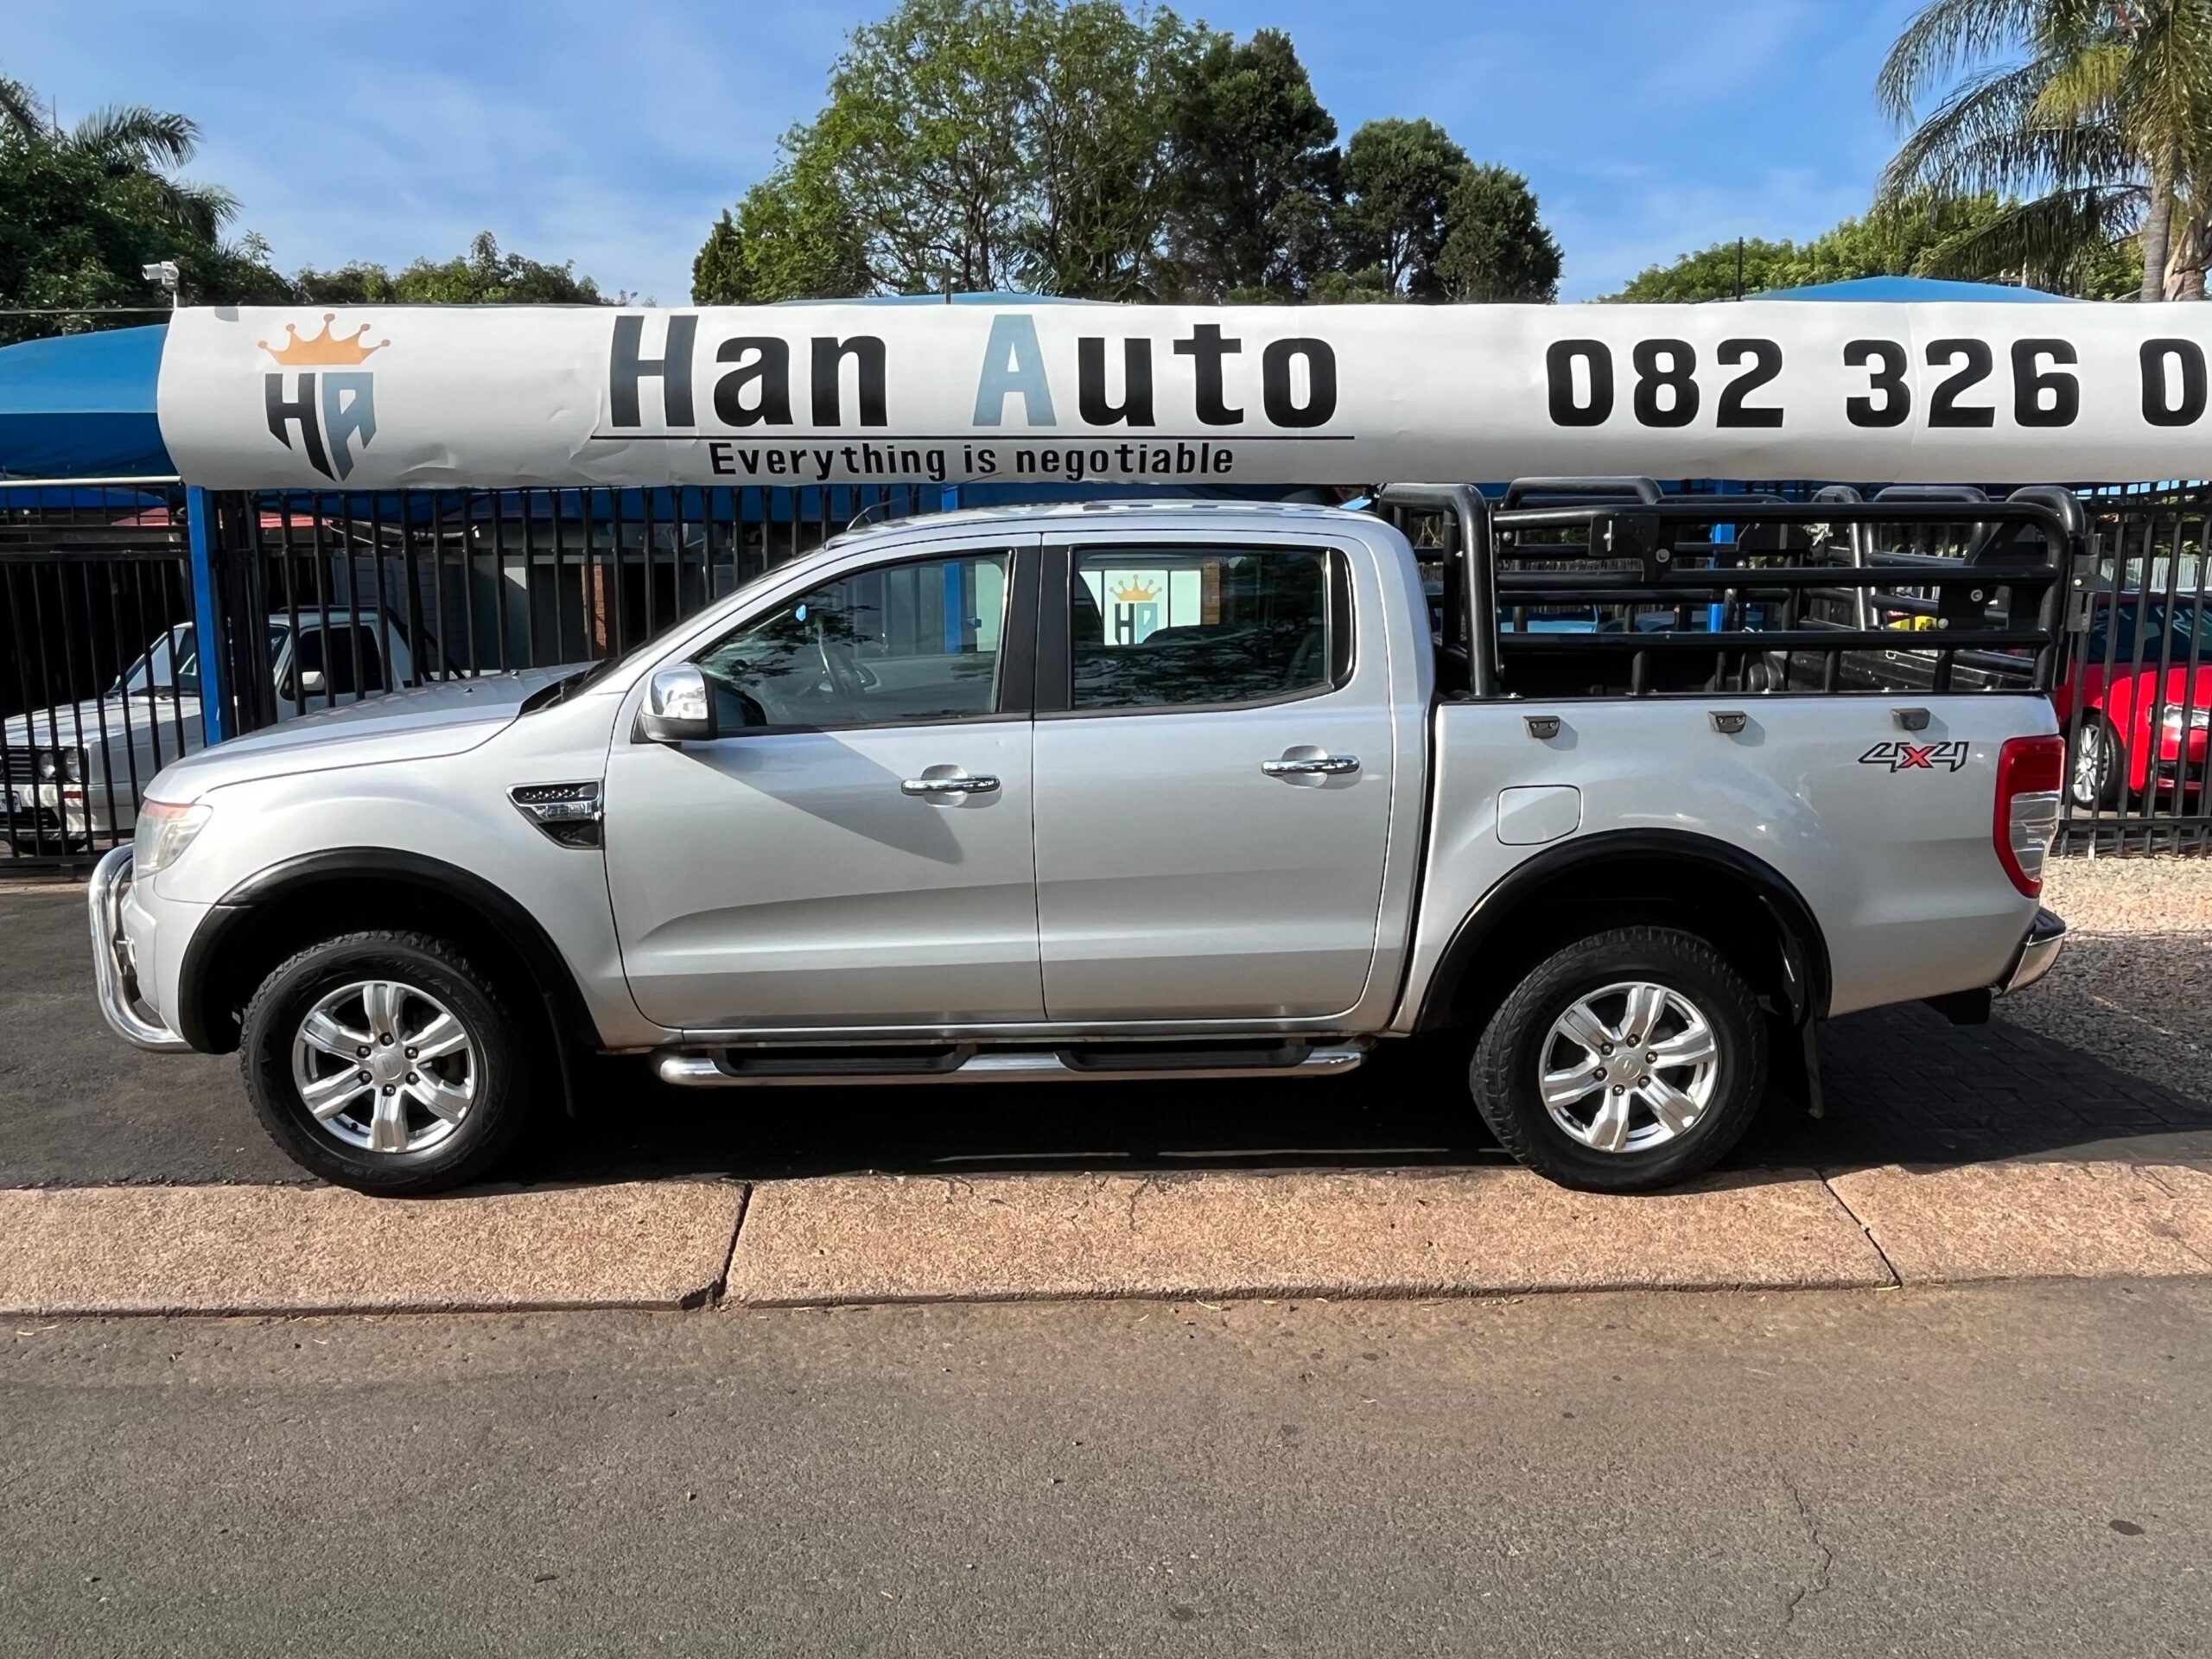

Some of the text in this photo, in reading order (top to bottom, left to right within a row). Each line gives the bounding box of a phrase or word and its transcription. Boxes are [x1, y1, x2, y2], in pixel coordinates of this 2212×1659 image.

[610, 314, 1337, 428] Han Auto
[1546, 338, 2208, 428] 082 326 0
[709, 442, 1234, 482] Everything is negotiable
